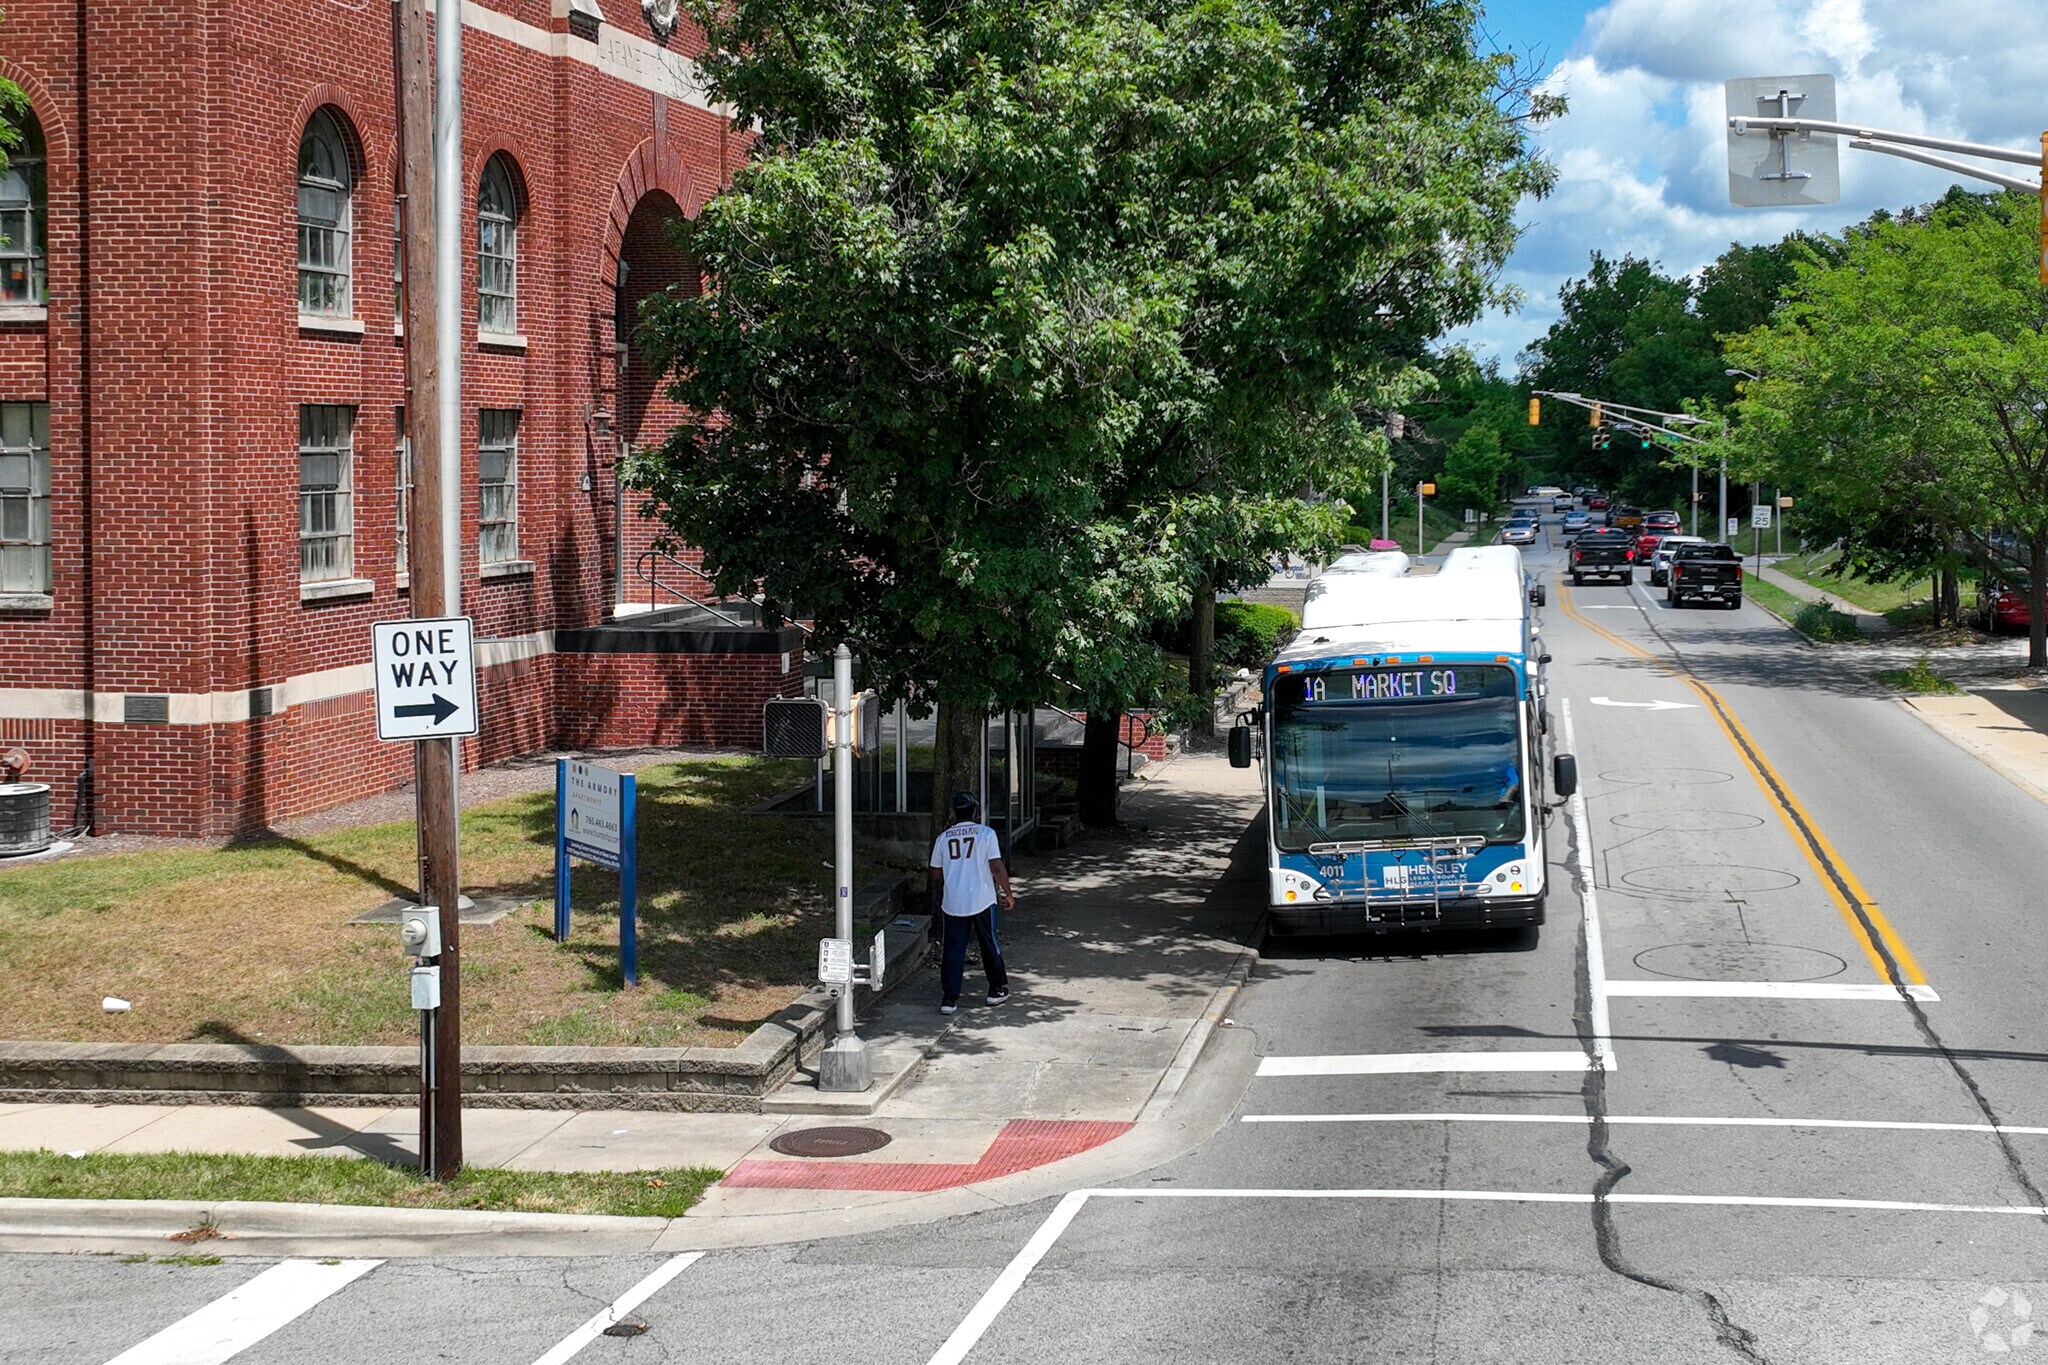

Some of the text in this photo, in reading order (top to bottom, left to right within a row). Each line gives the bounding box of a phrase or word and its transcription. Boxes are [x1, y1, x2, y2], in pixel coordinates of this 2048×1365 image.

[1754, 516, 1769, 526] 25
[392, 629, 455, 657] ONE
[391, 660, 458, 688] WAY
[1304, 670, 1456, 701] 1A MARKET SQ
[571, 776, 618, 797] THE ARMORY
[572, 791, 602, 806] APARTMENTS
[948, 837, 975, 860] 07
[1319, 864, 1345, 879] 4011
[1409, 863, 1468, 875] HENSLEY
[1385, 876, 1408, 885] HLG
